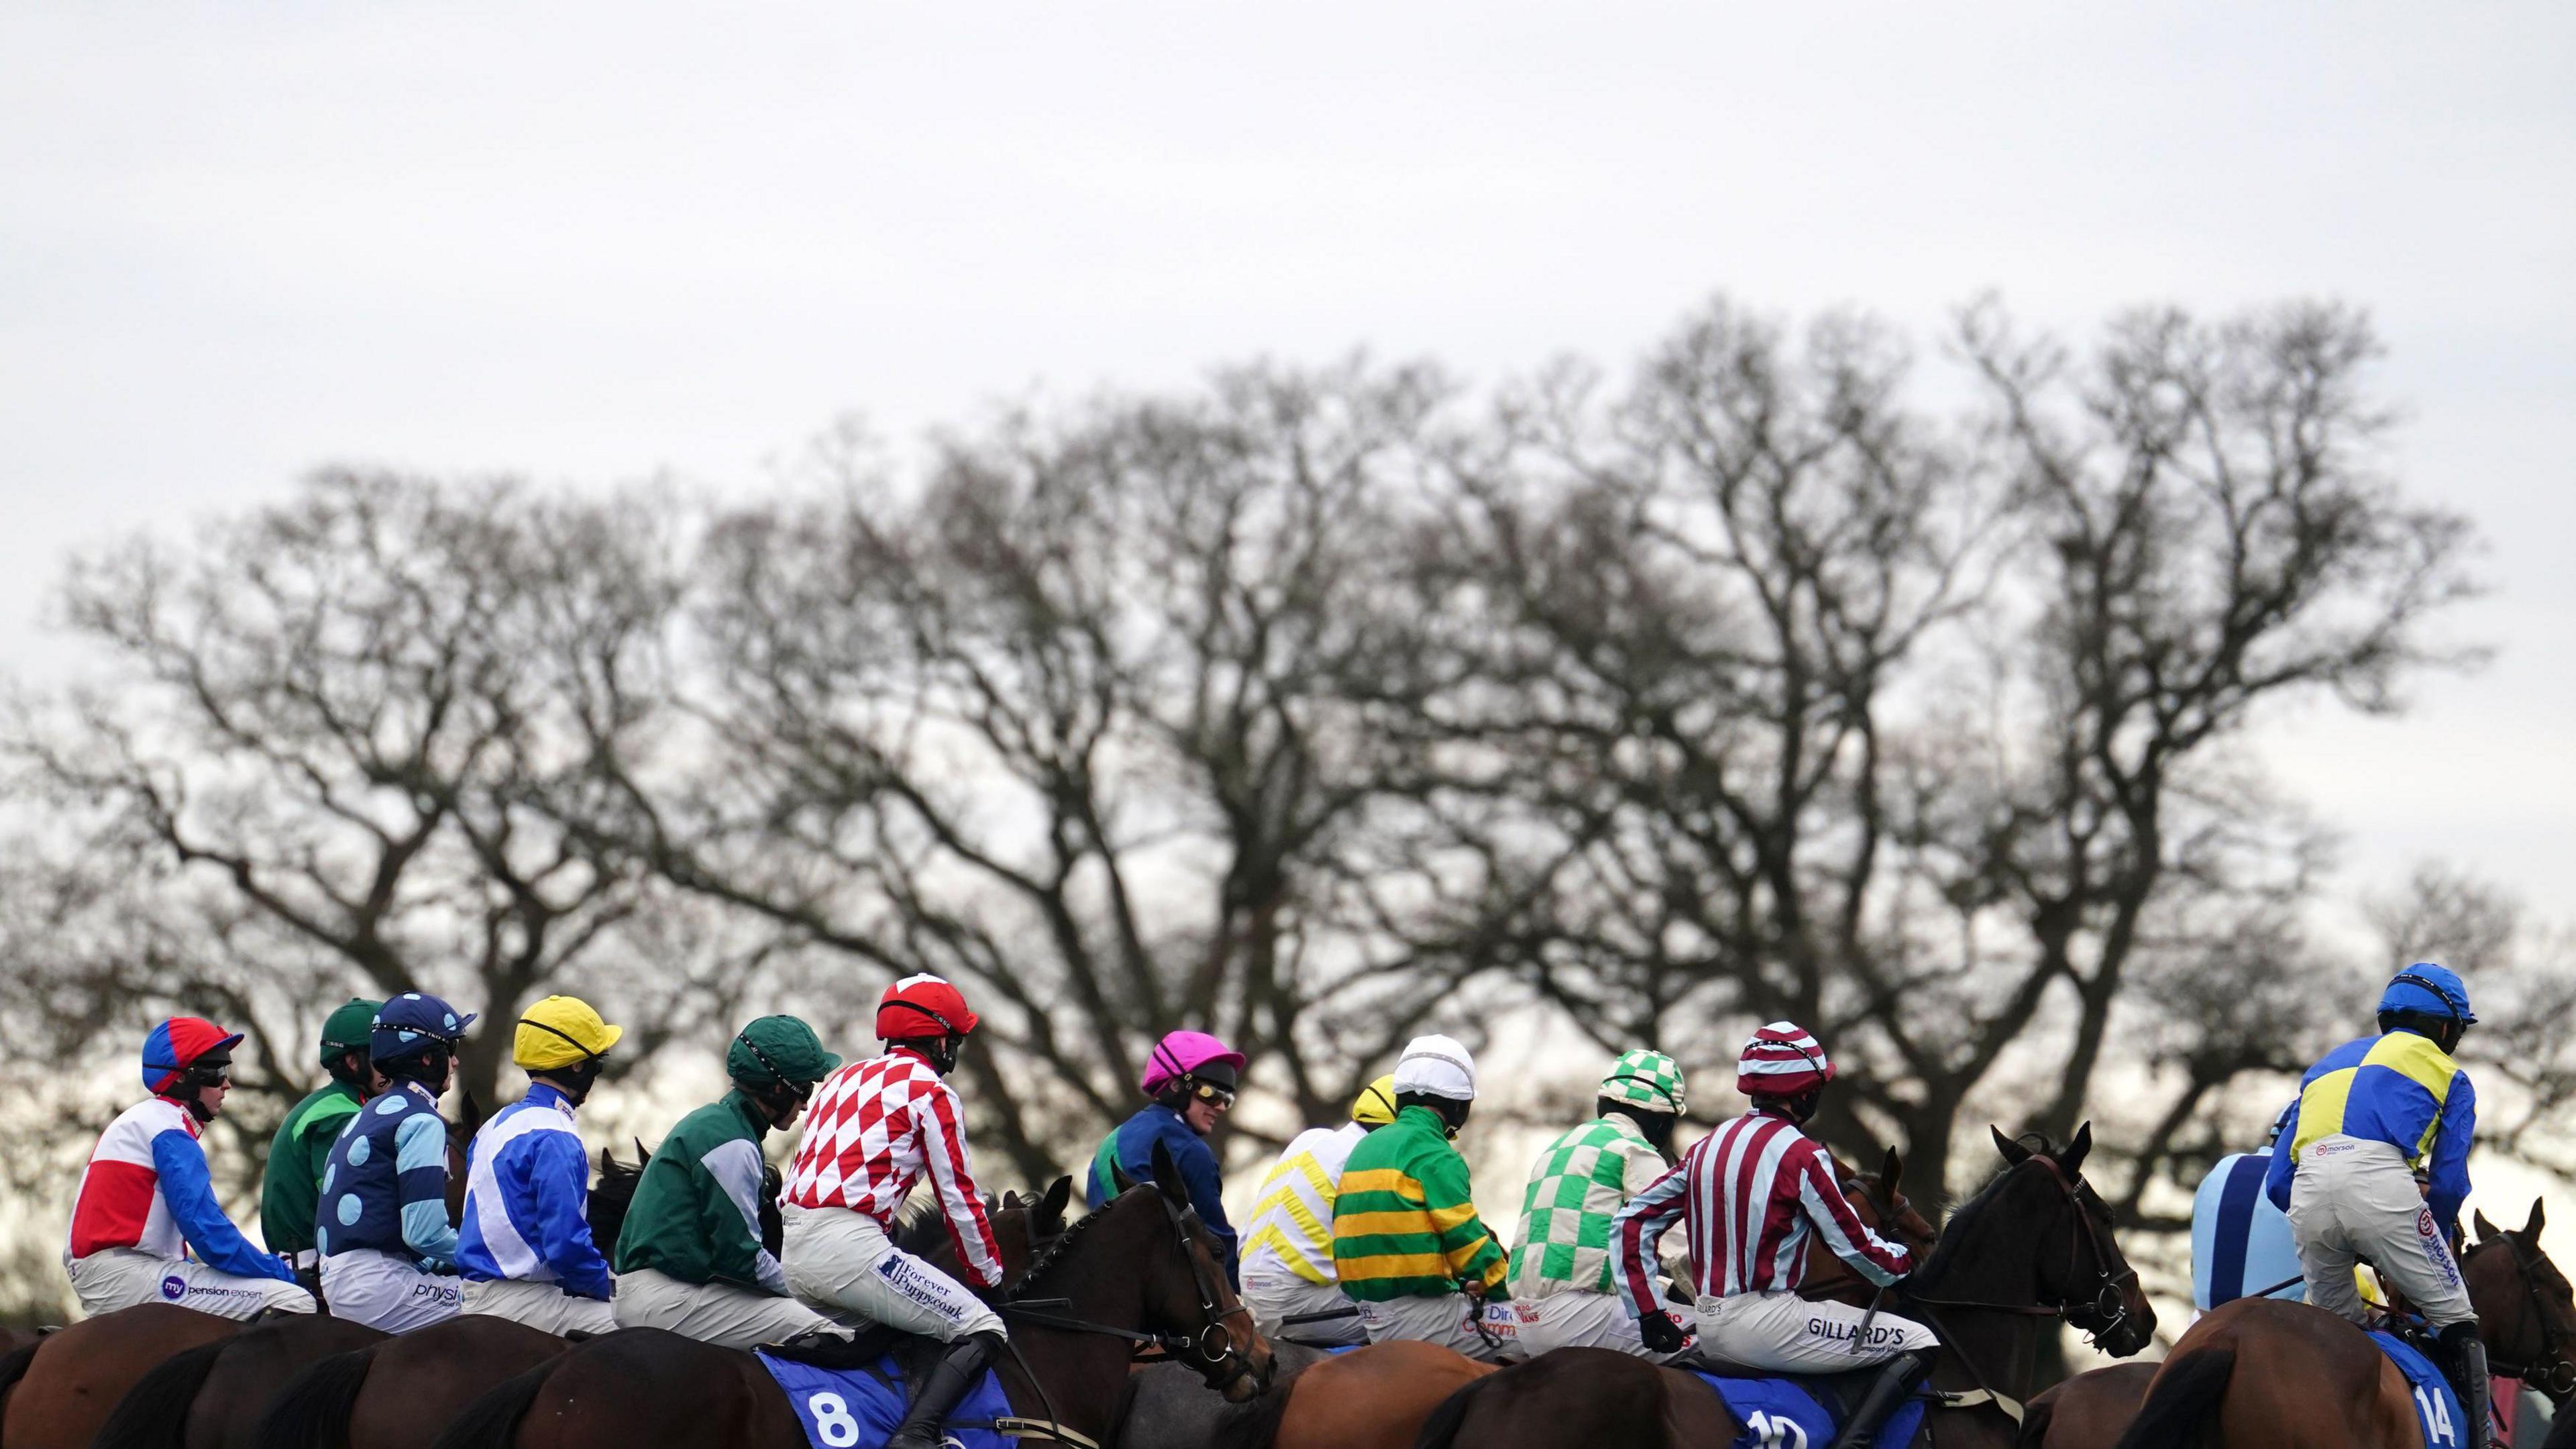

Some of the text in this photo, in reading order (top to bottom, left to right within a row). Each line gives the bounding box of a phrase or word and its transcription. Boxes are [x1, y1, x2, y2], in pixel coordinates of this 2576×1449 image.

[2327, 1144, 2355, 1152] morson
[902, 1264, 951, 1297] Forever
[2430, 1234, 2459, 1287] morson
[165, 1281, 264, 1300] my pension expert
[894, 1273, 963, 1320] Puppy.co.uk
[1809, 1318, 1905, 1345] GILLARD'S
[809, 1392, 859, 1448] 8
[2415, 1385, 2455, 1448] 14
